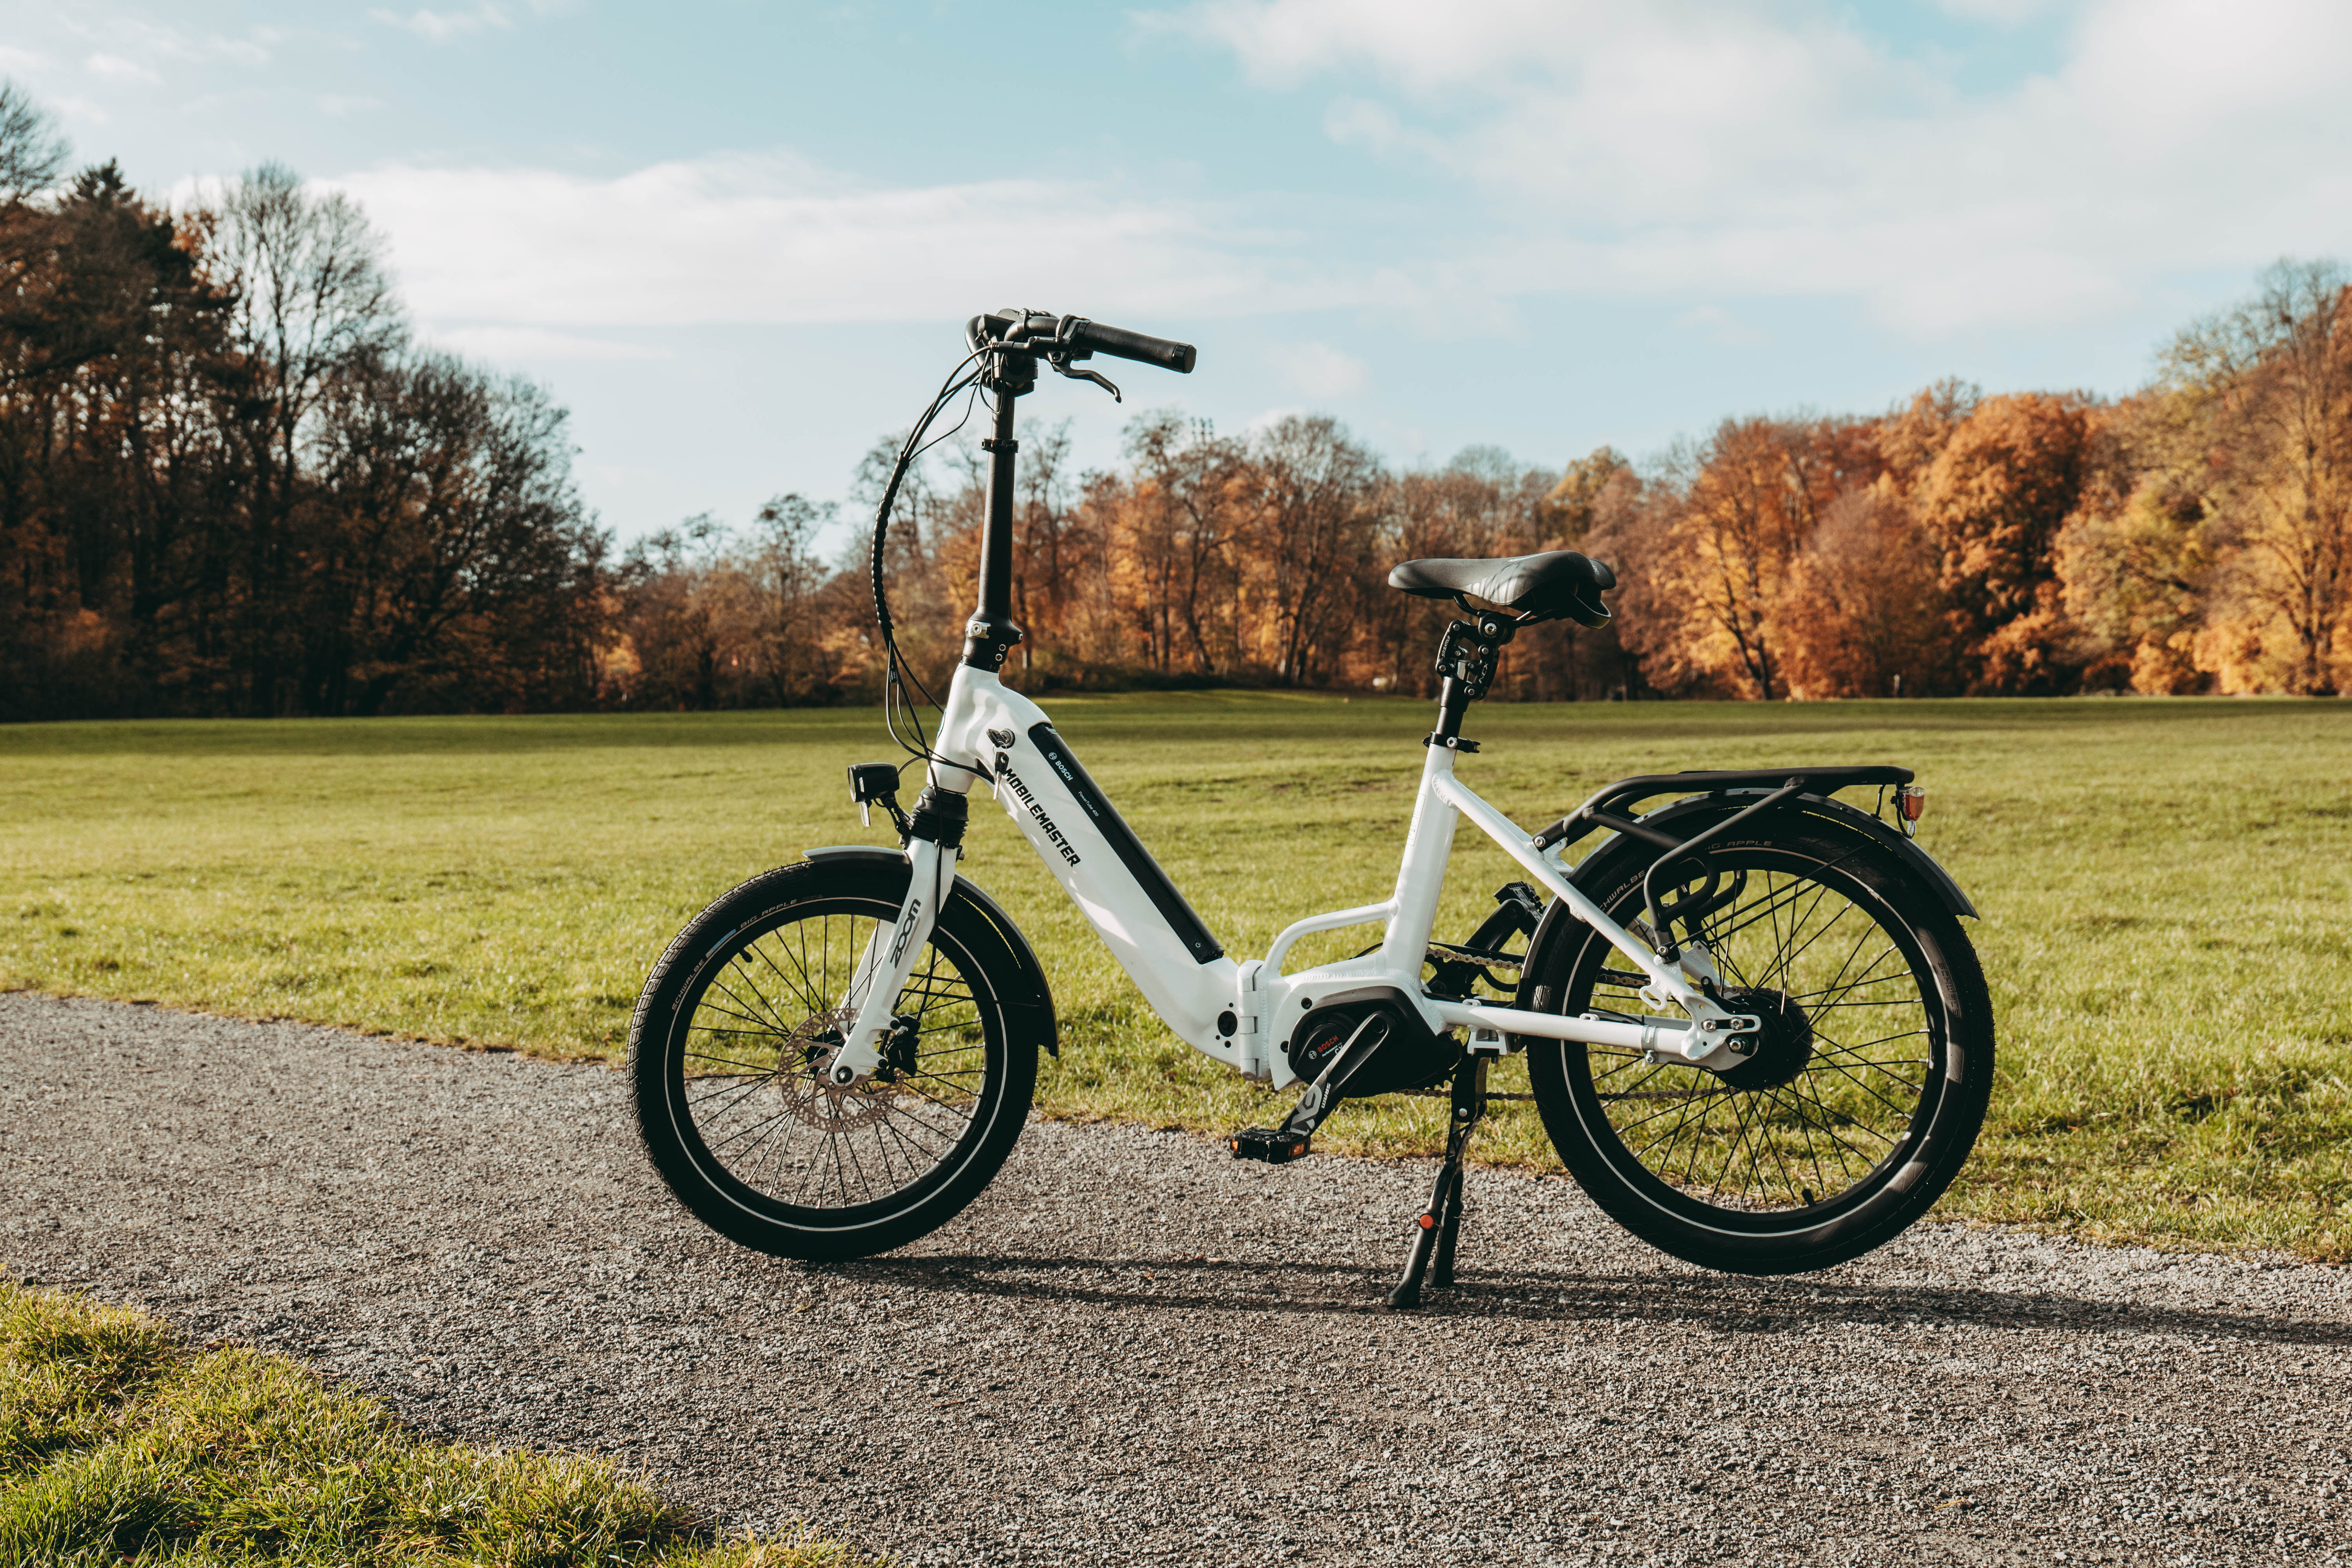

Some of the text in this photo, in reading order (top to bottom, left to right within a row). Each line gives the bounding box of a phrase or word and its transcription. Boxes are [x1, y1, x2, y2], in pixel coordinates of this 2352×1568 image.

[1478, 661, 1488, 684] NCX
[1055, 760, 1073, 781] BOSCH
[1078, 791, 1093, 810] PowerTube
[1004, 768, 1081, 867] MOBILEMASTER
[1599, 869, 1646, 911] CHWALBE
[740, 899, 797, 929] BIG APPLE
[671, 959, 704, 1011] SCHWALBE
[1318, 1034, 1339, 1053] BOSCH
[1321, 1082, 1331, 1109] SRAM
